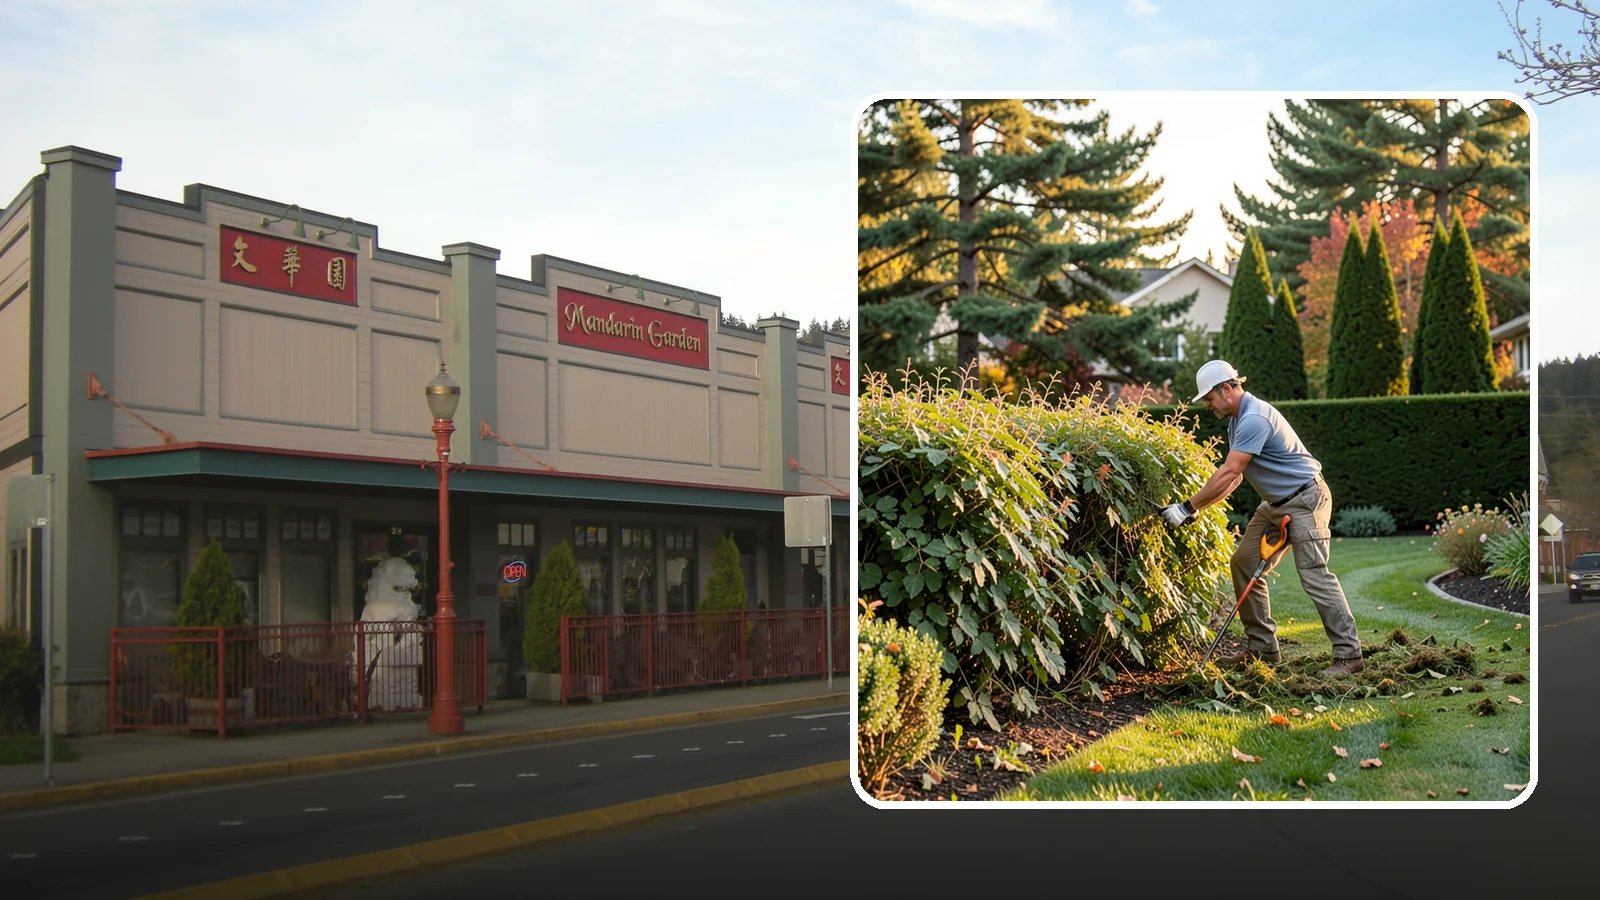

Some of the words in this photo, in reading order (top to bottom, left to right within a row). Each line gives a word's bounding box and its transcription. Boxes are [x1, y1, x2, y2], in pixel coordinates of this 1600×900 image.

[564, 302, 644, 341] Mandarin
[648, 320, 701, 352] Garden
[503, 565, 527, 578] OPEN
